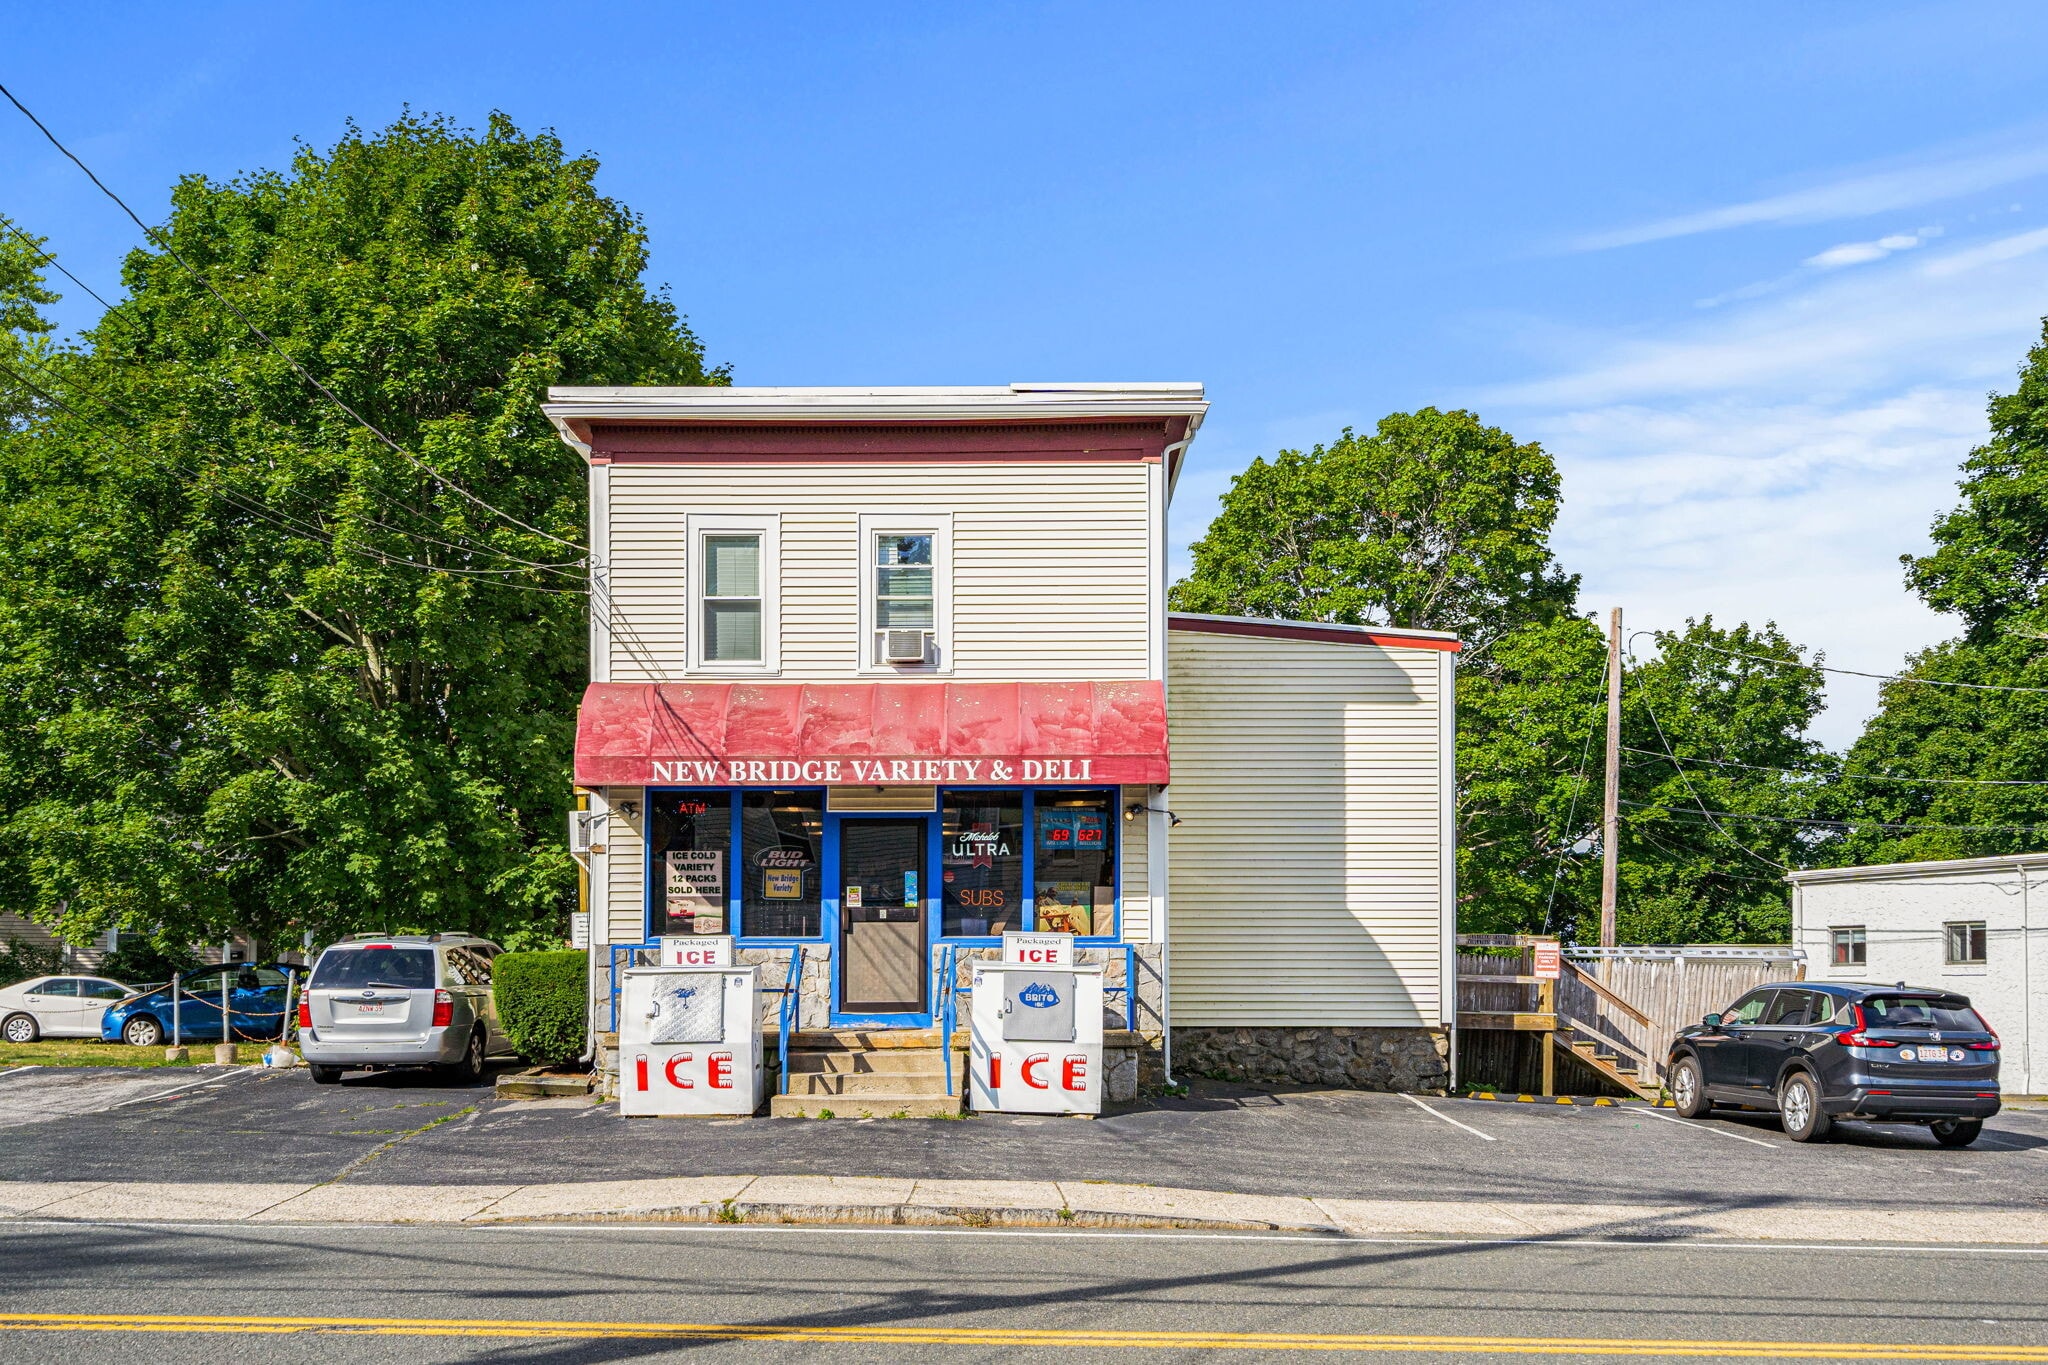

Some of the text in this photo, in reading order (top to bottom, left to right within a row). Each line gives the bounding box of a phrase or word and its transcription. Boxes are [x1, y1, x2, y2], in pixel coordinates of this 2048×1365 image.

[651, 759, 1092, 782] NEW BRIDGE VARIETY & DELI
[679, 802, 706, 815] ATM
[959, 831, 1001, 842] Michelob
[1053, 829, 1070, 841] 69
[1078, 829, 1103, 841] 627
[768, 850, 804, 859] BUD
[952, 842, 1010, 856] ULTRA
[672, 851, 716, 860] ICE COLD
[674, 863, 714, 872] VARIETY
[760, 858, 810, 867] LIGHT
[672, 874, 717, 883] 12 PACKS
[767, 873, 799, 884] New Bridge
[668, 886, 721, 894] SOLD HERE
[773, 883, 793, 893] Variety
[960, 889, 1005, 907] SUBS
[1016, 937, 1062, 945] Packaged
[676, 950, 716, 965] ICE
[1019, 949, 1058, 963] ICE
[1025, 993, 1055, 1002] BRITO
[636, 1051, 733, 1091] ICE
[990, 1051, 1087, 1091] ICE
